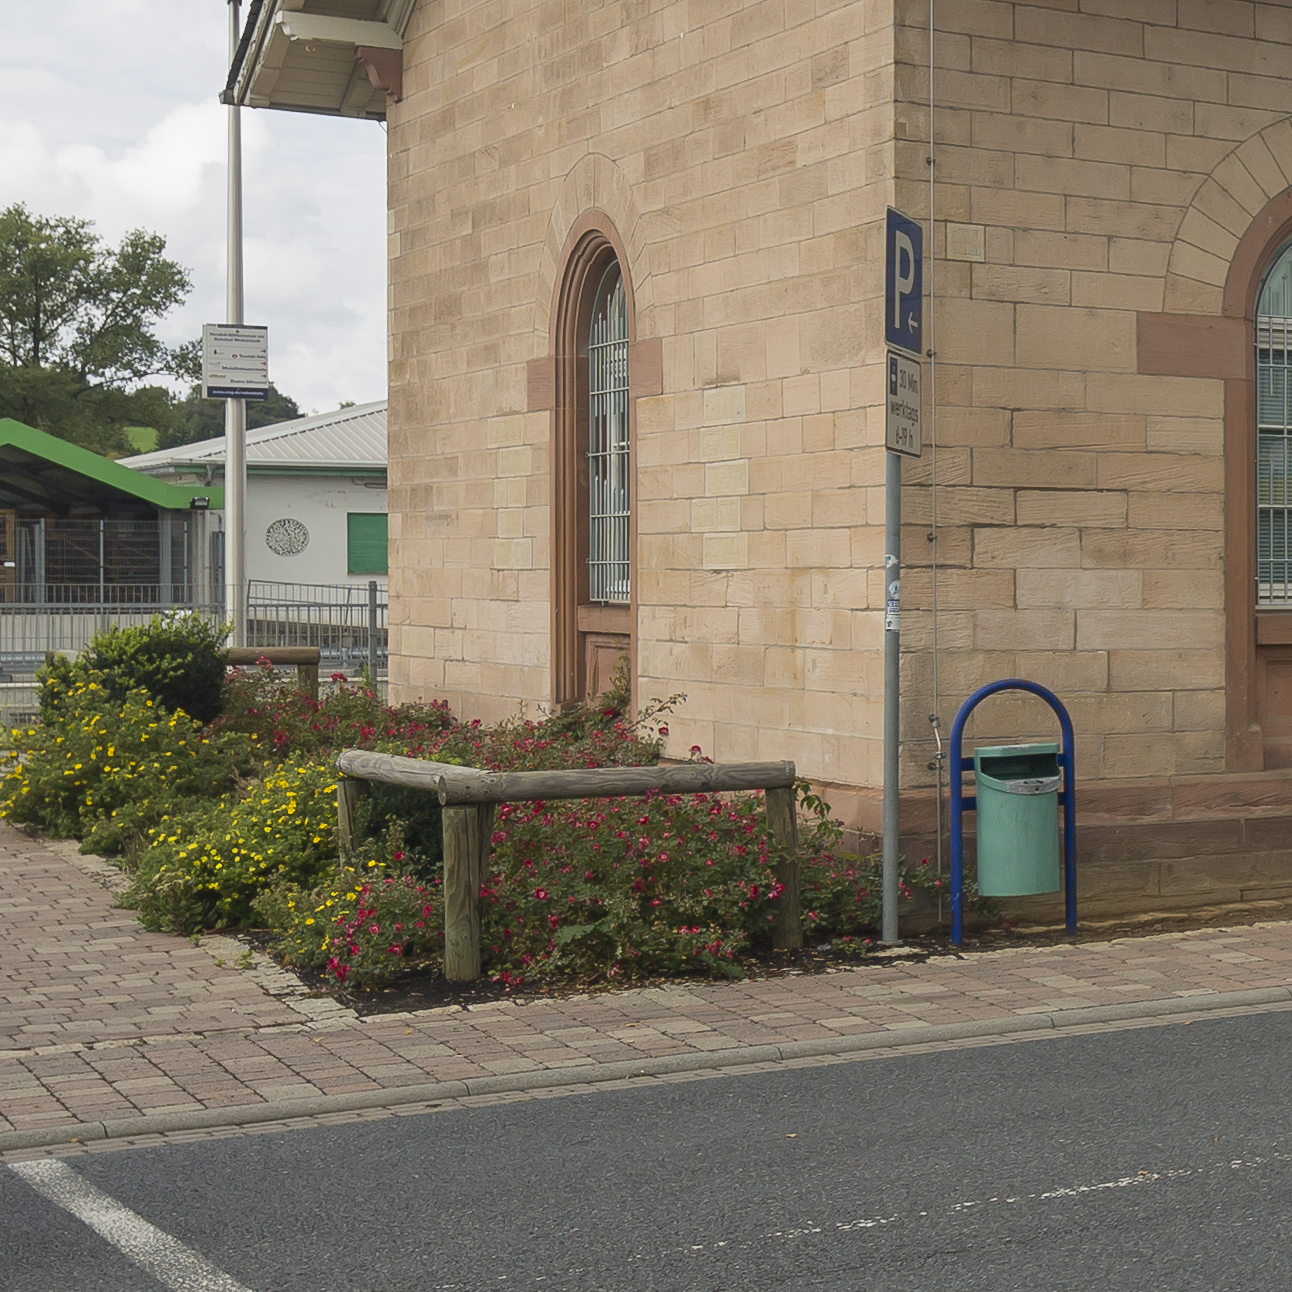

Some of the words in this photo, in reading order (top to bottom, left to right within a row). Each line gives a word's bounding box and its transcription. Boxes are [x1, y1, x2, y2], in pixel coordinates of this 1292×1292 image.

[895, 230, 914, 329] P
[900, 369, 907, 389] 30
[908, 371, 919, 395] Min.
[890, 400, 919, 426] werktags
[896, 425, 907, 446] 6-19
[908, 428, 914, 448] h
